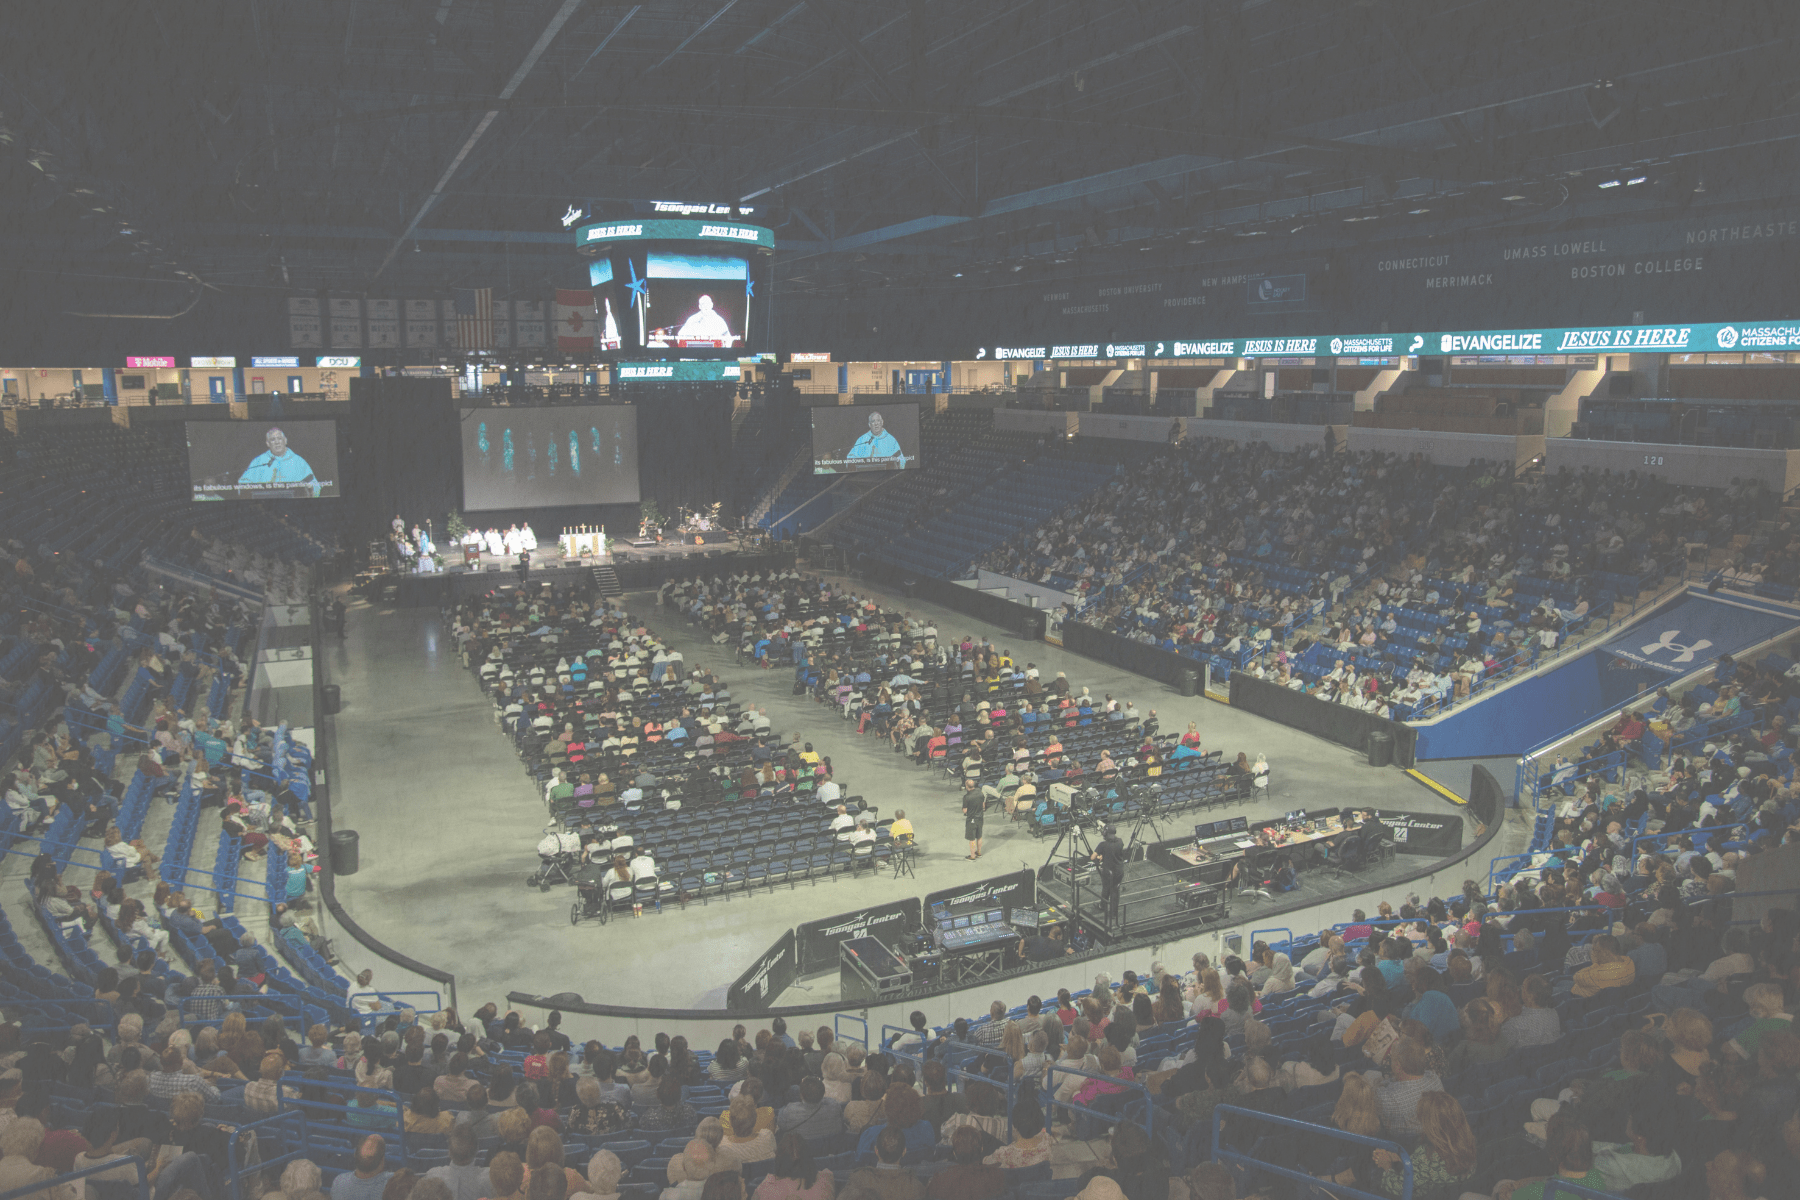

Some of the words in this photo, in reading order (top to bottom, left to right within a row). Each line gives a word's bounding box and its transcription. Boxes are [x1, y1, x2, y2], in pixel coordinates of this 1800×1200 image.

[654, 202, 708, 215] Tsongas
[708, 204, 754, 215] Cener
[587, 227, 606, 240] JESUS
[606, 226, 616, 237] IS
[616, 225, 642, 237] HERE
[699, 225, 727, 237] JESUS
[728, 228, 736, 238] IS
[1686, 221, 1797, 244] NORTHEASTE
[1503, 246, 1547, 261] UMASS
[1553, 241, 1607, 256] LOWELL
[1378, 255, 1450, 271] CONNECTICUT
[1571, 264, 1626, 279] BOSTON
[1634, 258, 1704, 275] COLLEGE
[1202, 278, 1218, 287] NEW
[1426, 274, 1493, 289] MERRIMACK
[1099, 287, 1121, 297] BOSTON
[1123, 283, 1163, 295] UNIVERSITY
[1043, 292, 1070, 302] VERMONT
[1164, 296, 1206, 308] PROVIDENCE
[1062, 304, 1109, 315] MASSACHUSETTS
[1741, 326, 1800, 337] MASSACHU
[1344, 338, 1393, 346] MASSACHUSETTS
[1452, 333, 1542, 351] EVANGELIZE
[1557, 331, 1611, 351] JESUS
[1613, 330, 1633, 346] IS
[1634, 328, 1691, 345] HERE
[1741, 336, 1787, 346] CITIZENS
[1003, 347, 1045, 359] EVANGELIZE
[1051, 346, 1070, 358] JESUS
[1070, 346, 1078, 356] IS
[1078, 345, 1098, 356] HERE
[1183, 342, 1234, 355] EVANGELIZE
[1242, 340, 1274, 355] JESUS
[1274, 340, 1284, 352] IS
[1285, 339, 1317, 352] HERE
[1344, 345, 1368, 353] CITIZENS
[1381, 344, 1393, 352] LIFE
[329, 358, 348, 366] DCU
[646, 366, 673, 377] HERE
[1643, 455, 1664, 466] 120
[193, 484, 203, 492] its
[1615, 649, 1646, 662] UNDER
[1644, 660, 1684, 673] ARMOUR
[1382, 820, 1408, 828] ngas
[1407, 819, 1443, 829] Center
[950, 891, 987, 906] Tsongas
[987, 883, 1018, 896] Center
[825, 921, 866, 936] Tsongas
[867, 912, 902, 926] Center
[744, 967, 767, 993] Tsongas
[767, 949, 785, 971] Center
